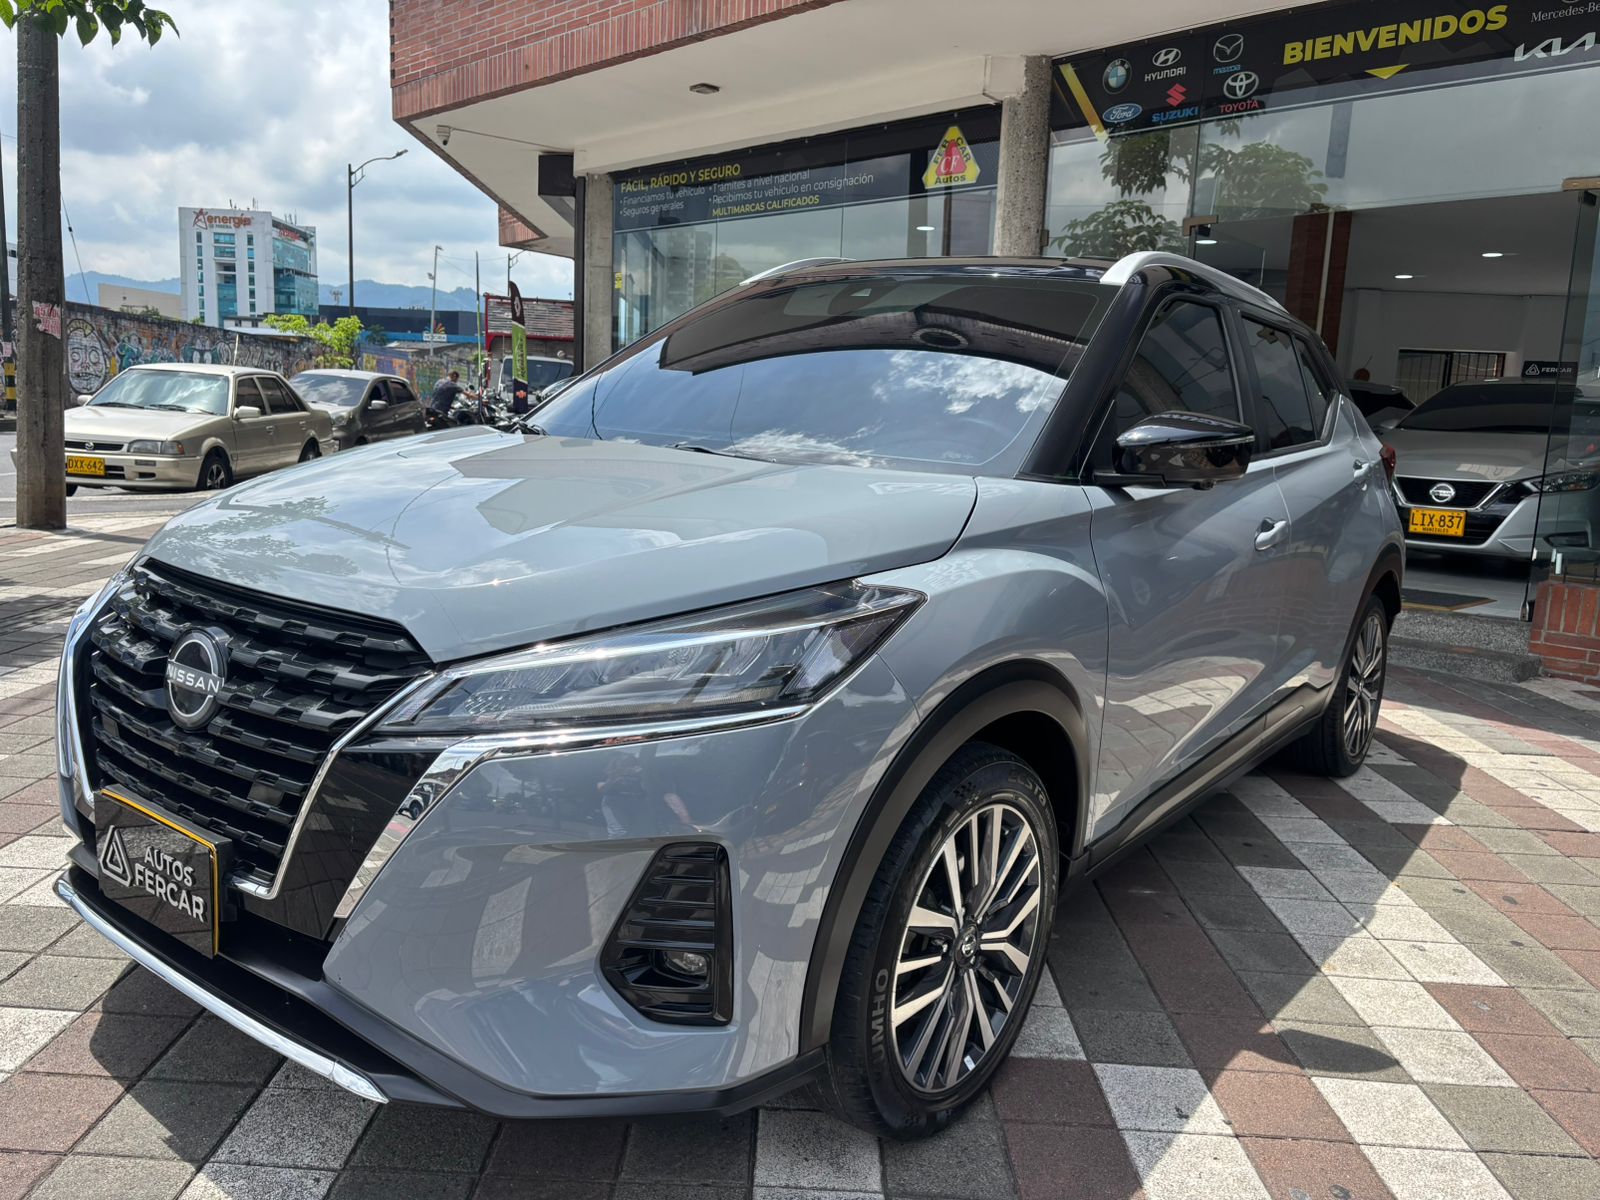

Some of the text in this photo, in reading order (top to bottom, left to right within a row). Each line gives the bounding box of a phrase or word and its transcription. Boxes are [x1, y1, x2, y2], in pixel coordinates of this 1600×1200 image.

[1282, 5, 1508, 65] BIENVENIDOS
[1513, 31, 1596, 62] KIA
[1144, 66, 1187, 82] HYUNDAI
[1109, 106, 1135, 120] Ford
[1151, 106, 1200, 123] SUZUKI
[1219, 100, 1260, 114] TOYOTA
[941, 155, 960, 173] CF
[620, 163, 741, 193] FÁCIL, RÁPIDO Y SEGURO
[753, 173, 773, 186] nivel
[774, 168, 810, 184] nacional
[935, 175, 966, 185] Autos
[623, 191, 665, 205] Financiamos
[666, 191, 674, 199] tu
[712, 189, 753, 205] Recibimos
[754, 189, 763, 199] tu
[800, 183, 812, 192] en
[813, 173, 874, 191] consignación
[623, 200, 685, 218] Seguros generales
[712, 194, 820, 217] MULTIMARCAS CALIFICADOS
[166, 663, 220, 693] NISSAN
[144, 846, 194, 887] AUTOS
[134, 862, 204, 923] FERCAR
